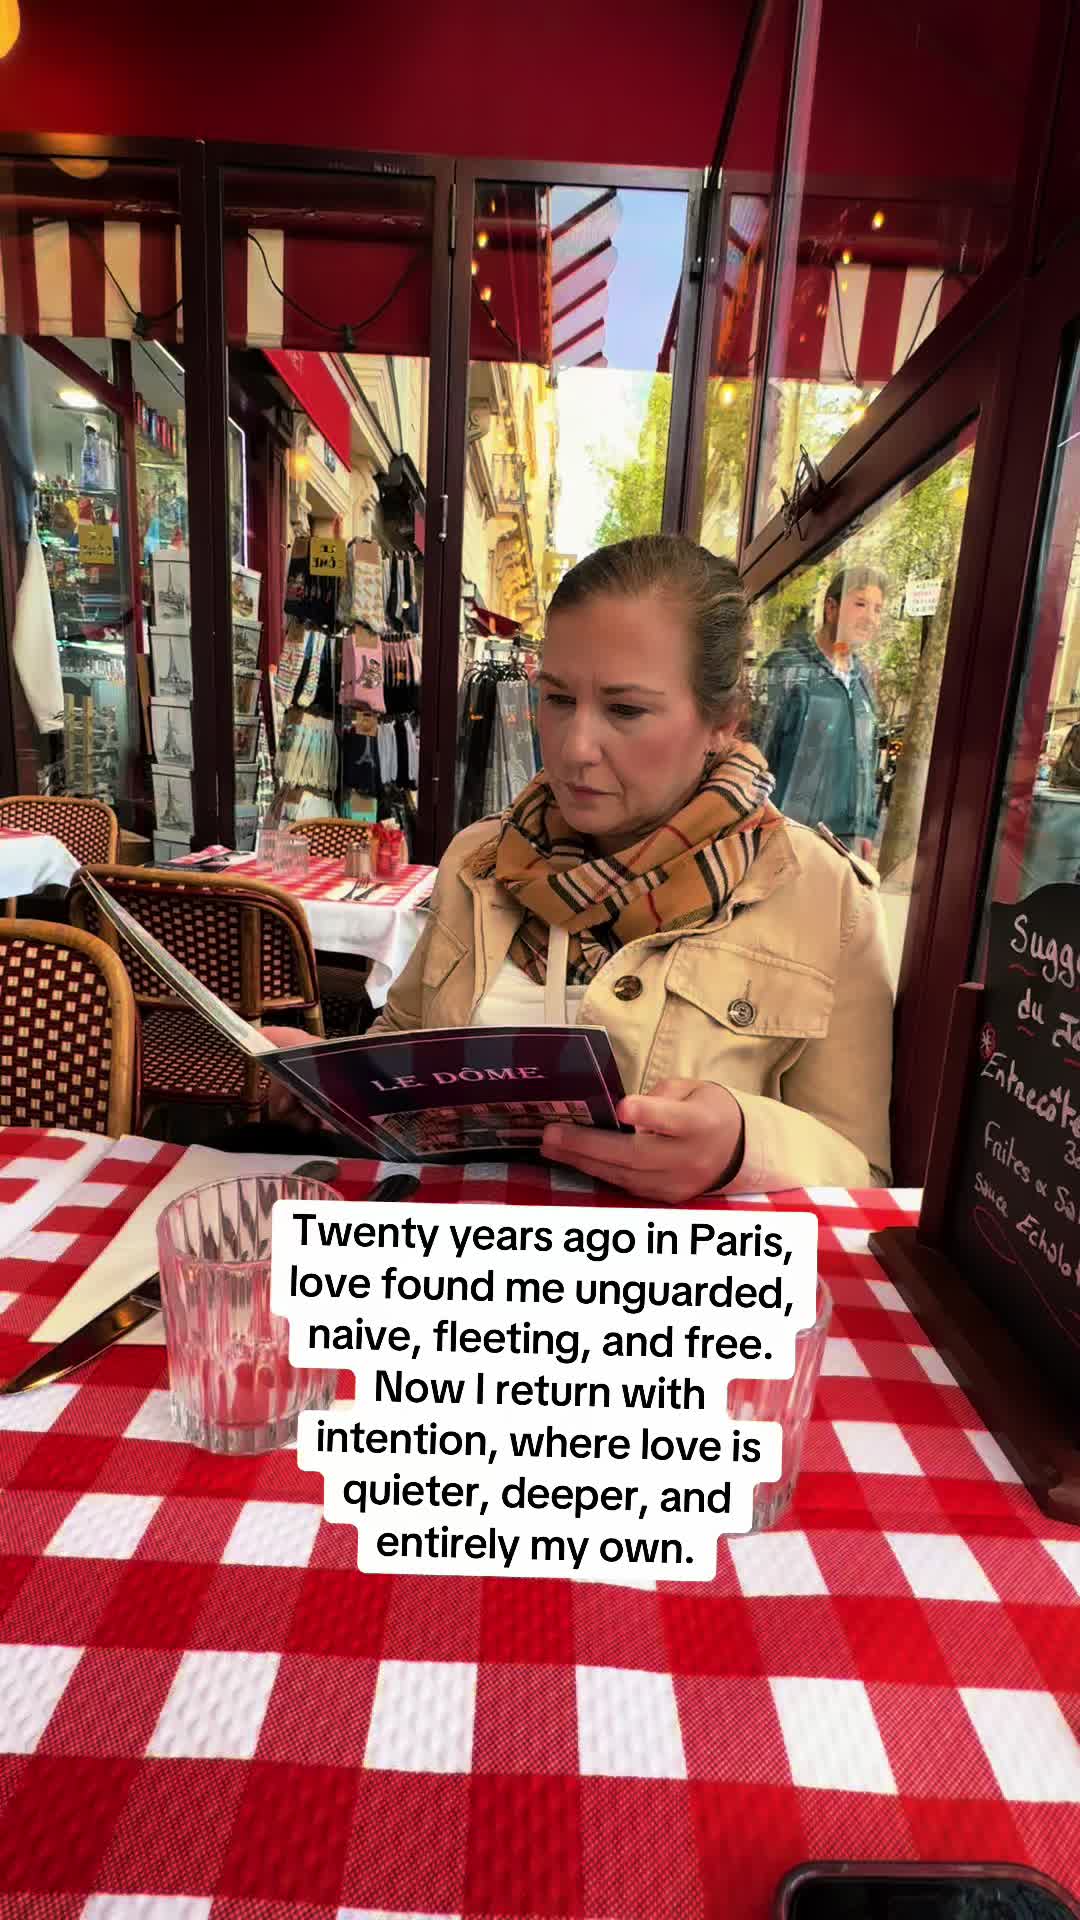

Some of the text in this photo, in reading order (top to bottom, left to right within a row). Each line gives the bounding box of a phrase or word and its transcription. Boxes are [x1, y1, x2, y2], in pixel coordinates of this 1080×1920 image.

[1010, 914, 1080, 988] Sugg
[1017, 987, 1044, 1025] du
[369, 1067, 545, 1092] LE DÔME
[984, 1120, 1031, 1183] Frites
[1054, 1185, 1080, 1224] Sa
